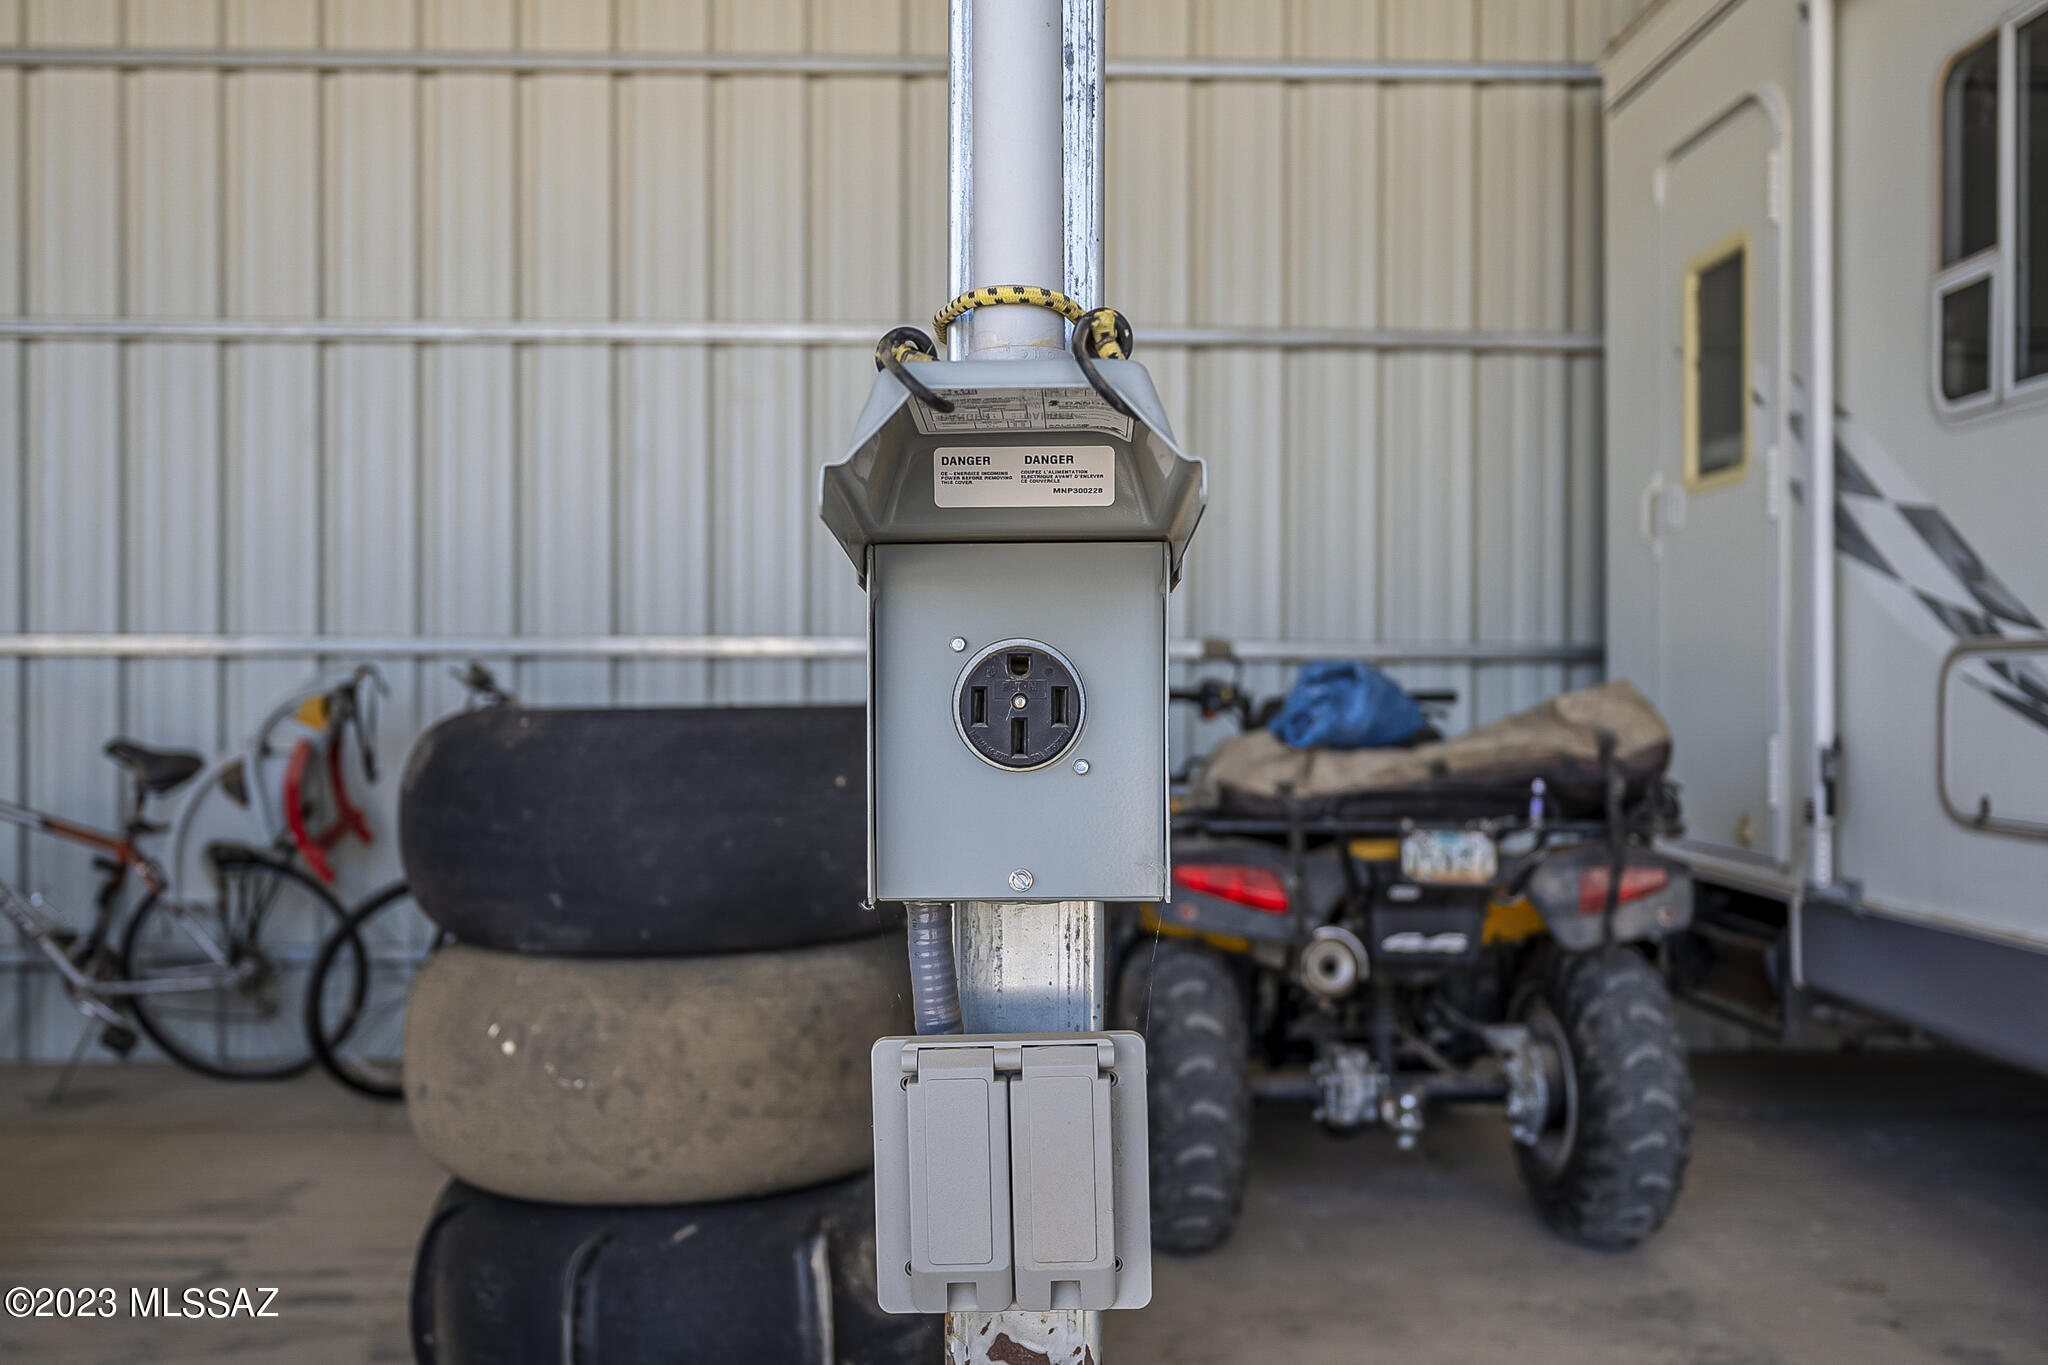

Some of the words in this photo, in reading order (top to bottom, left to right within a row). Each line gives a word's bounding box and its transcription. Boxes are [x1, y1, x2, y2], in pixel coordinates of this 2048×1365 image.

[941, 456, 991, 466] DANGER
[1024, 455, 1074, 465] DANGER
[1052, 487, 1104, 495] MNP300228
